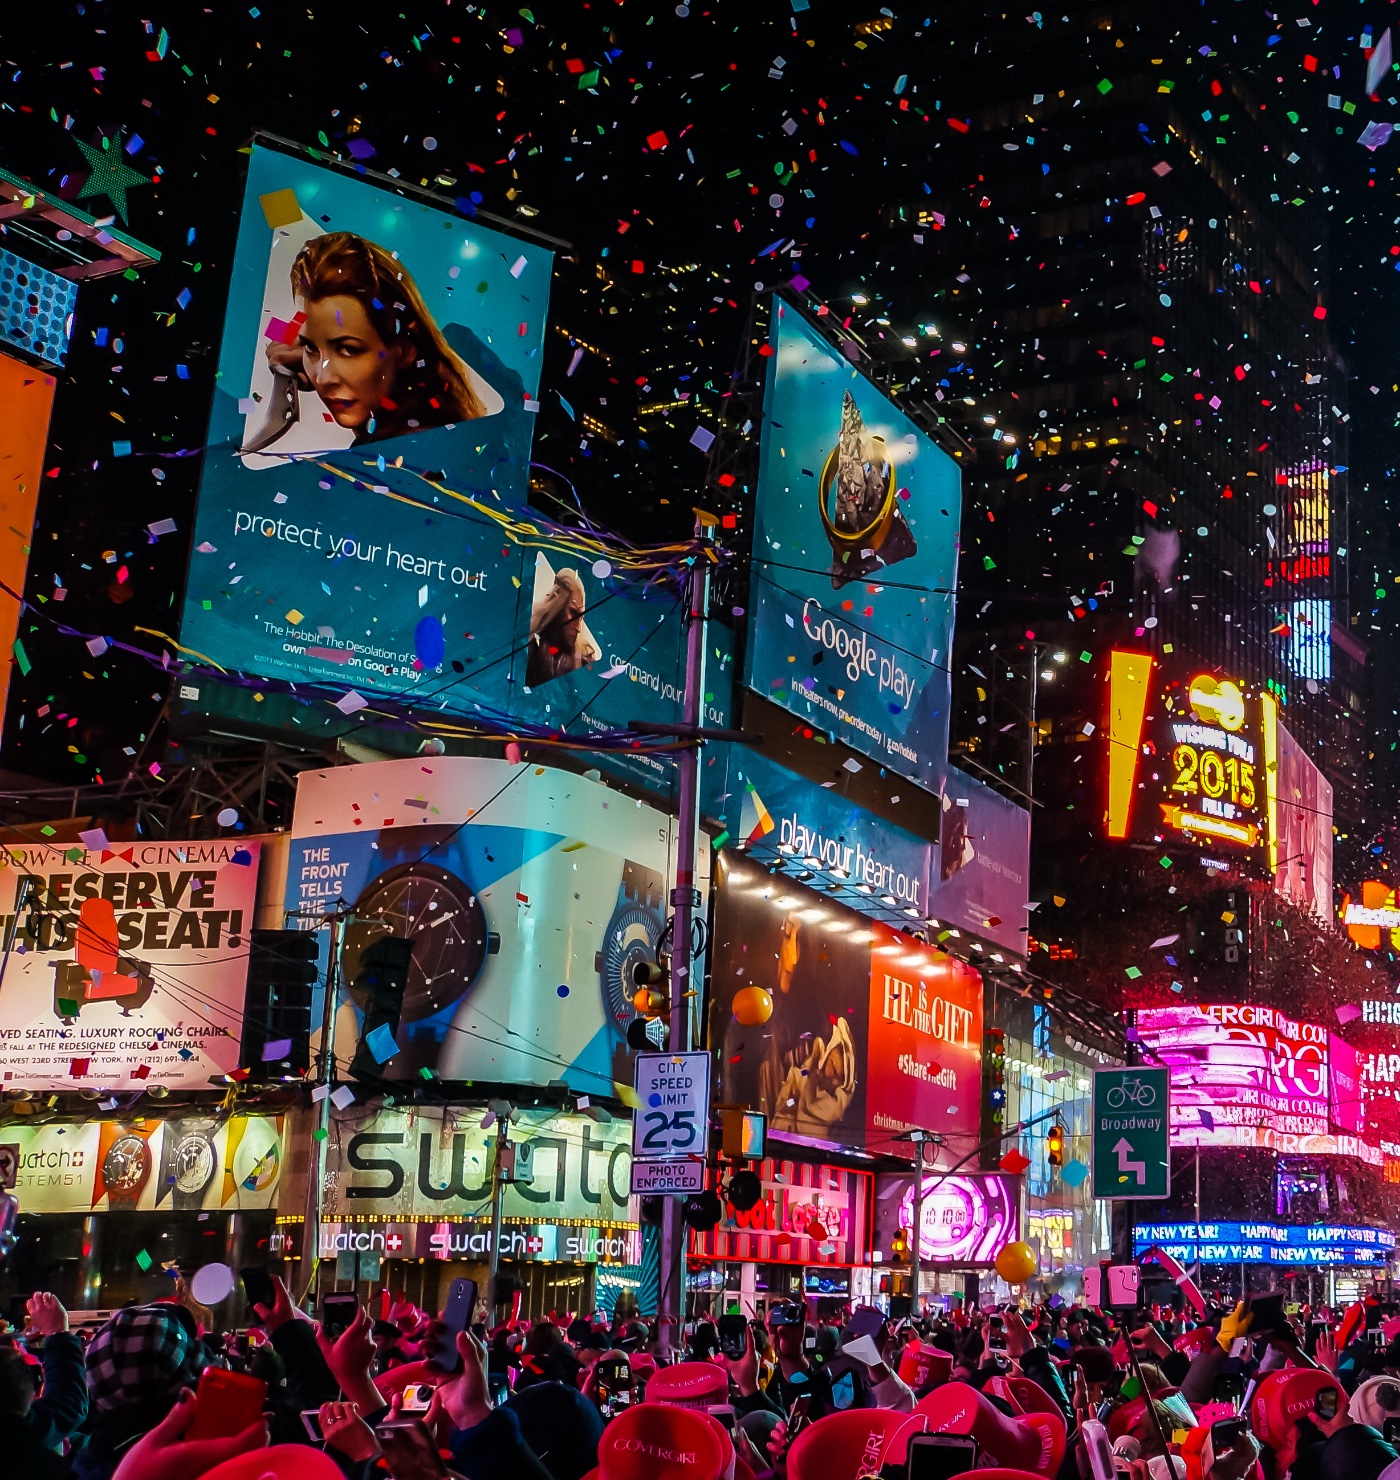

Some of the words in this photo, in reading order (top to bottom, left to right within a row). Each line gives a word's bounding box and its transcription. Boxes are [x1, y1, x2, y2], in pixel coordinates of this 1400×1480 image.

[234, 511, 322, 549] protect
[326, 534, 382, 562] your
[386, 543, 446, 581] heart
[451, 566, 488, 592] out
[264, 621, 284, 637] The
[325, 636, 345, 650] The
[346, 640, 398, 663] Desolation
[398, 651, 410, 664] of
[283, 642, 306, 656] own
[803, 597, 877, 682] Google
[879, 655, 916, 710] play
[348, 656, 362, 668] on
[400, 666, 422, 683] Play
[660, 681, 683, 705] your
[708, 706, 724, 727] out
[1172, 744, 1256, 808] 2015
[303, 847, 330, 864] THE
[780, 812, 816, 855] play
[818, 834, 855, 870] your
[856, 844, 895, 894] heart
[896, 872, 920, 906] out
[301, 862, 350, 880] FRONT
[13, 870, 218, 912] RESERVE
[299, 880, 343, 898] TELLS
[298, 899, 326, 914] THE
[0, 912, 77, 952] HIS
[117, 909, 244, 949] SEAT!
[296, 918, 331, 933] TIME
[882, 973, 913, 1028] HE
[917, 988, 928, 1011] IS
[912, 1007, 931, 1035] THE
[931, 995, 973, 1050] GIFT
[80, 1027, 126, 1038] LUXURY
[129, 1026, 184, 1038] ROCKING
[39, 1042, 56, 1050] THE
[58, 1041, 116, 1050] REDESIGNED
[119, 1041, 159, 1050] CHELSE
[657, 1061, 688, 1074] CITY
[650, 1077, 693, 1090] SPEED
[655, 1093, 689, 1106] IMIT
[642, 1110, 697, 1149] 25
[1101, 1116, 1162, 1132] Broadway
[346, 1125, 634, 1207] swatc
[648, 1165, 686, 1176] PHOTO
[16, 1173, 83, 1187] STEM51
[636, 1177, 697, 1188] ENFORCED
[1151, 1225, 1178, 1240] NEW
[1178, 1224, 1220, 1239] YEAR!
[566, 1235, 626, 1257] swatch
[1161, 1245, 1192, 1260] APPY
[613, 1438, 700, 1464] COVERGIRL
